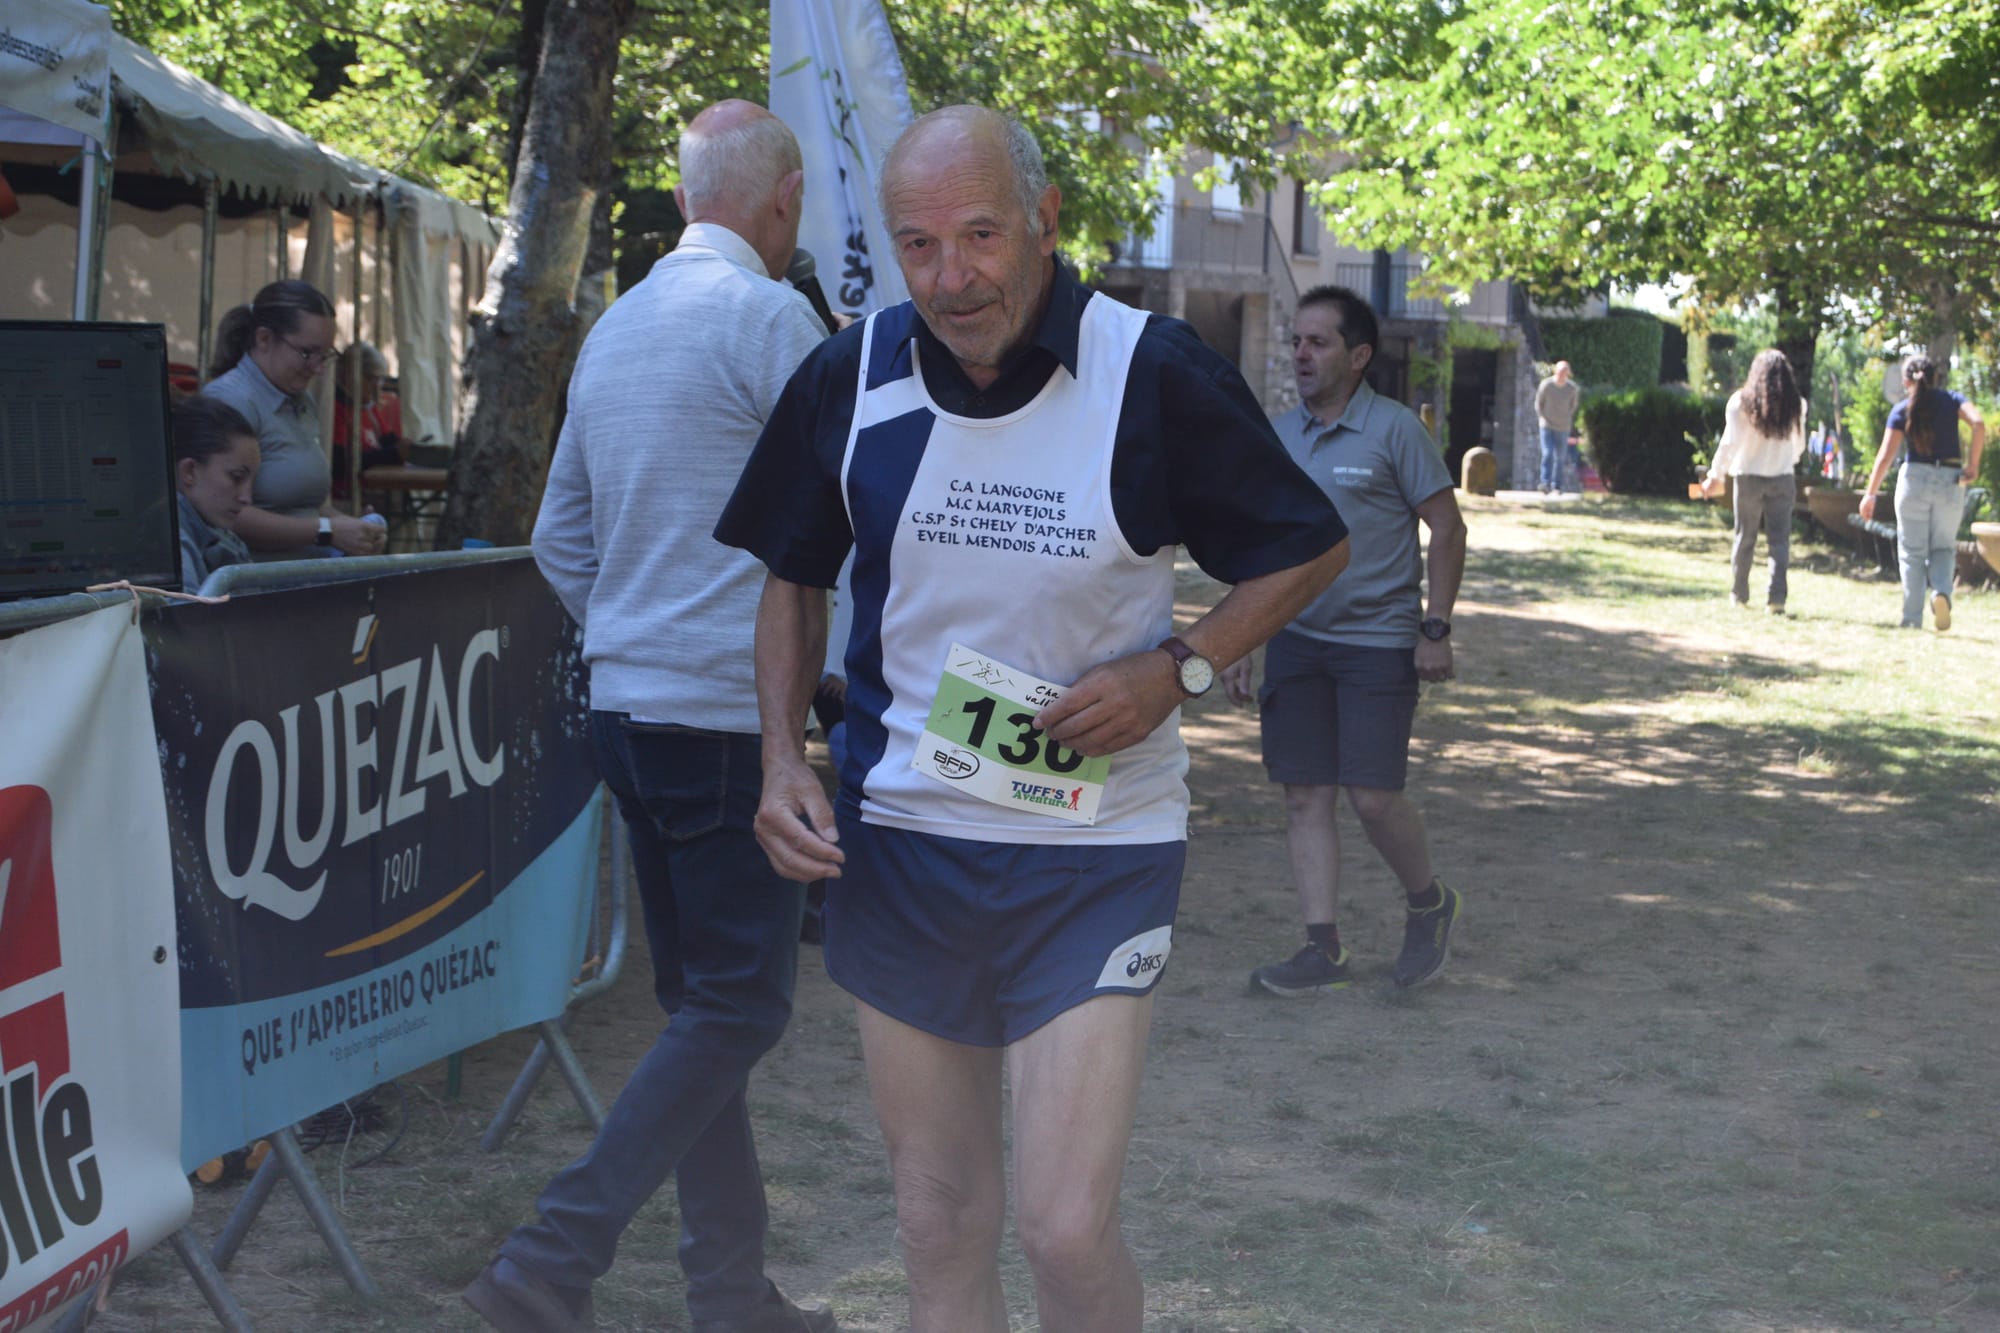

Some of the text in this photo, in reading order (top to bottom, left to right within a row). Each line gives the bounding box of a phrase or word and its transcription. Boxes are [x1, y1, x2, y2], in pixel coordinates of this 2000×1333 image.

[950, 479, 1066, 504] C.A LANGOGNE
[946, 497, 1066, 521] M.C MARVEJOLS
[912, 511, 1097, 542] C.S.P St CHELY D'APCHER
[917, 529, 1090, 560] EVEIL MENDOIS A.C.M.
[1025, 694, 1055, 707] vall
[205, 613, 504, 921] QUÉZAC
[933, 750, 972, 772] BFP
[1011, 780, 1065, 800] TUFF'S
[1012, 789, 1068, 809] Aventure
[382, 843, 422, 904] 1901
[241, 1016, 284, 1076] QUE
[290, 968, 415, 1054] S'APPELERIO
[0, 1071, 103, 1280] lle
